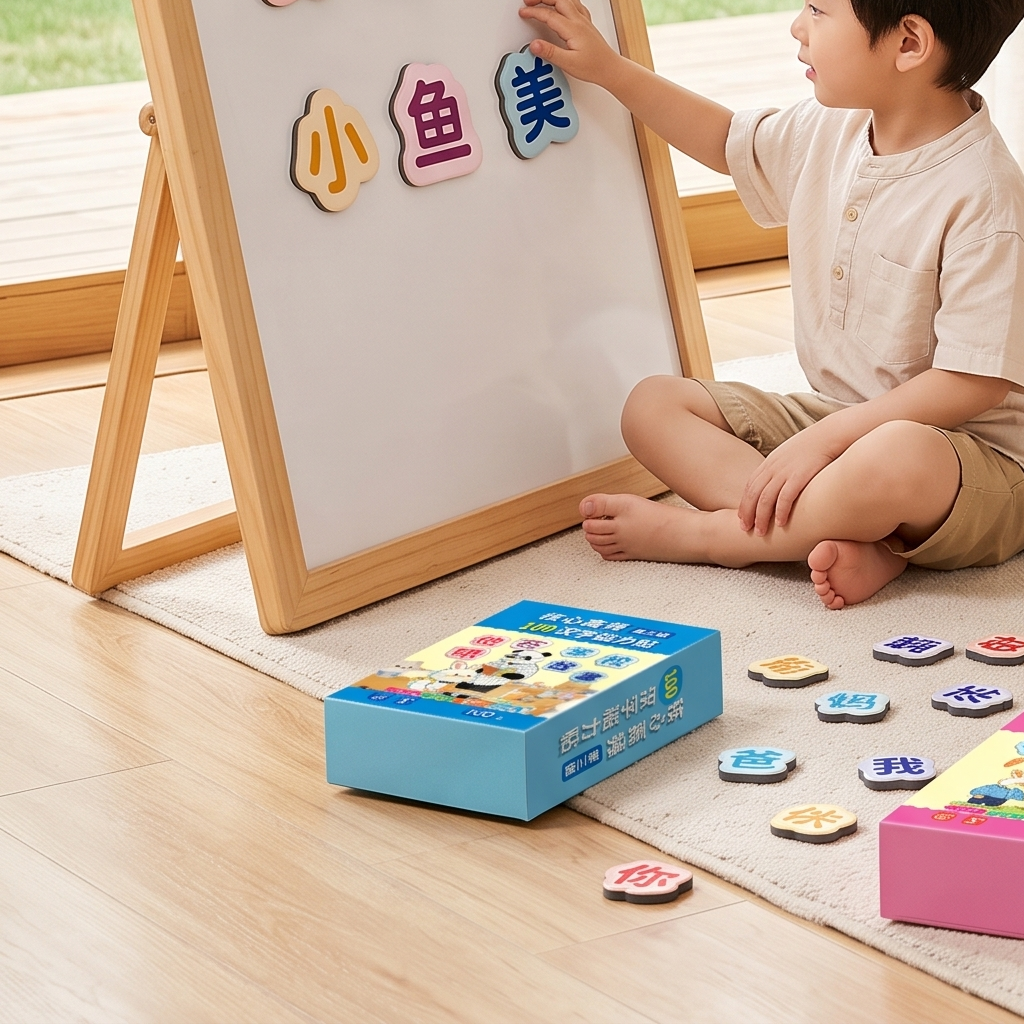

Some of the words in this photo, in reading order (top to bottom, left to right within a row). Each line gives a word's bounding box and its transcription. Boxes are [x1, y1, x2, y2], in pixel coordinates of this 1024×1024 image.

[310, 105, 369, 194] 小
[407, 79, 473, 169] 鱼
[511, 57, 571, 144] 美
[730, 750, 784, 769] 爸
[872, 756, 926, 776] 我
[613, 864, 681, 888] 你
